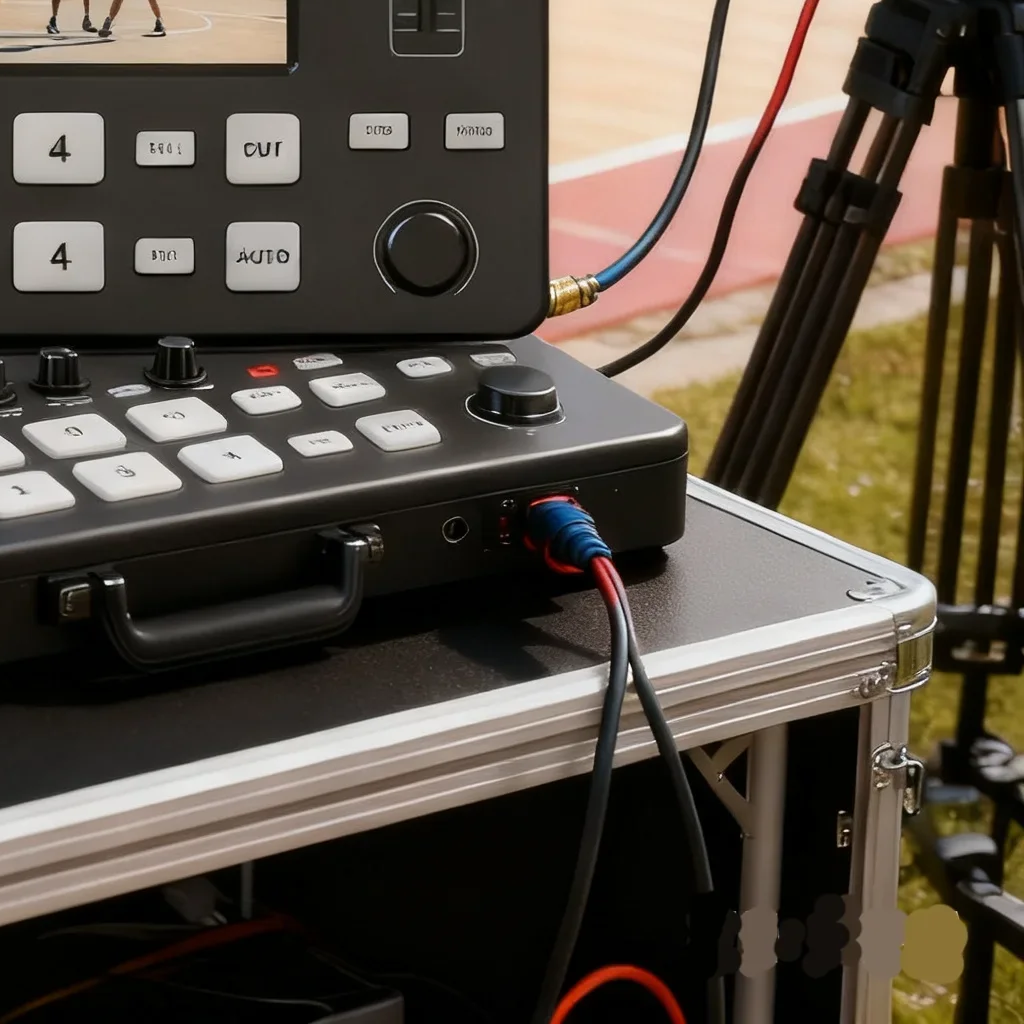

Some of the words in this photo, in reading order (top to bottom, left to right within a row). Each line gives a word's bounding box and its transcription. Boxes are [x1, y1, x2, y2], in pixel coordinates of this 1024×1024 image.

[48, 134, 72, 164] 4
[49, 242, 73, 271] 4
[236, 247, 290, 265] AUTO
